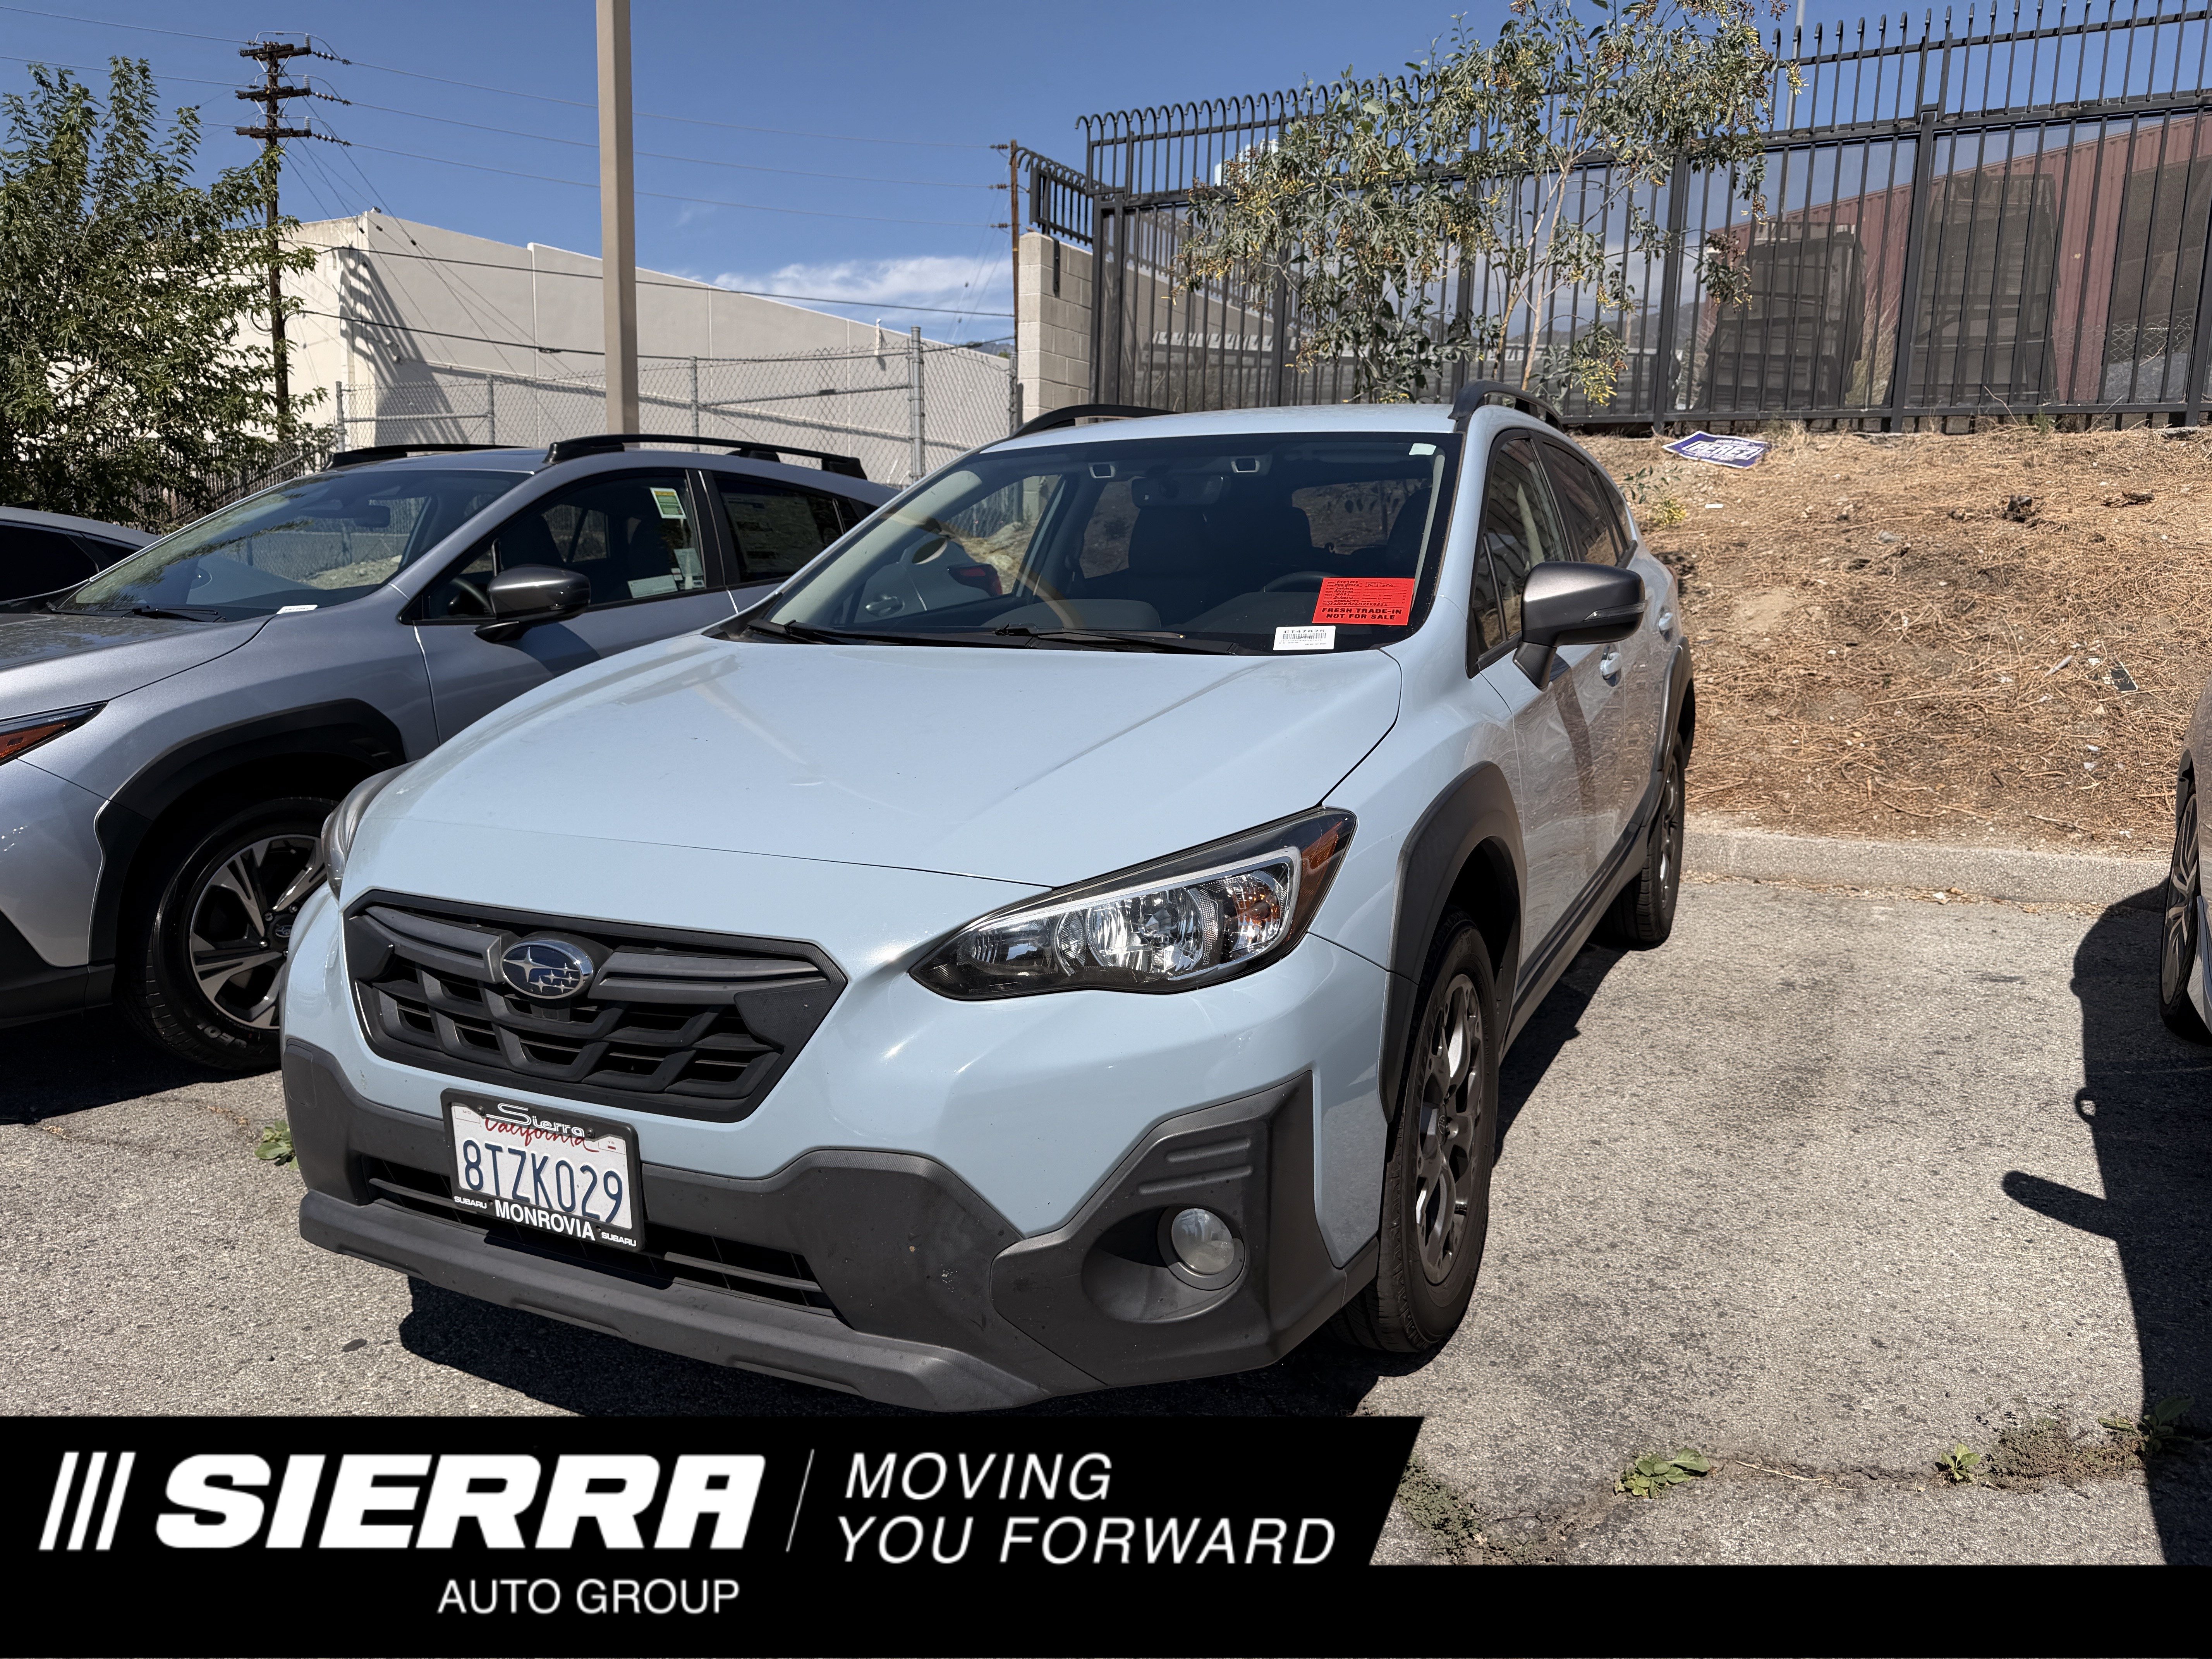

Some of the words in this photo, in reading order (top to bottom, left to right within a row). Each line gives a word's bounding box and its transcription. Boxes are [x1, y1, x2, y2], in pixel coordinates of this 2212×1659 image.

[1688, 443, 1759, 459] PEREZ
[486, 1103, 585, 1137] Sierra
[463, 1139, 623, 1223] 8TZK029
[454, 1196, 487, 1209] SUBARU
[495, 1200, 596, 1241] MONROVIA
[601, 1231, 636, 1247] SUBARU
